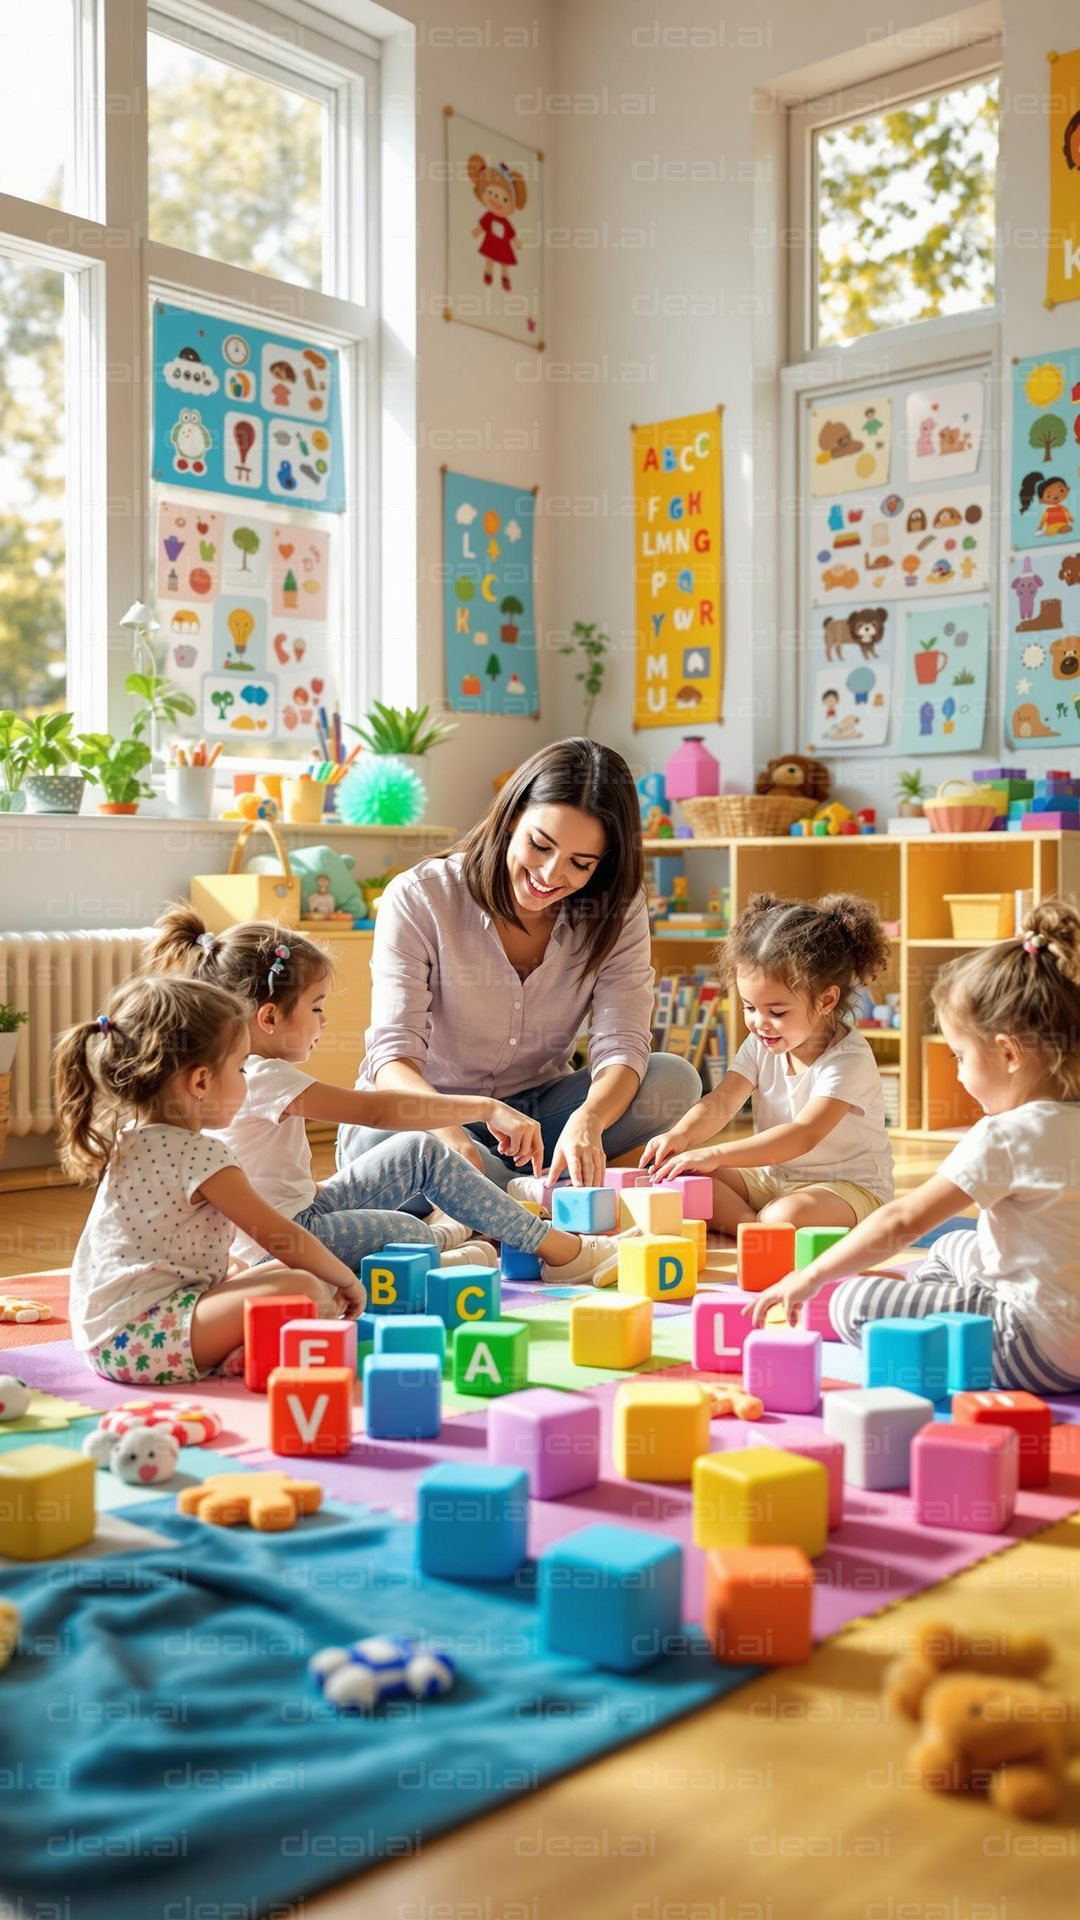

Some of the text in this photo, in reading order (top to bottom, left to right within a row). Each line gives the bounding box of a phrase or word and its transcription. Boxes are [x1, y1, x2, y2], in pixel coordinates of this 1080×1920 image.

[463, 532, 476, 559] L
[651, 571, 667, 598] P
[456, 607, 470, 634] K
[646, 654, 668, 681] M
[647, 687, 667, 713] U
[370, 1267, 397, 1306] B
[658, 1256, 684, 1291] D
[456, 1286, 486, 1321] C
[714, 1313, 741, 1356] L
[464, 1342, 502, 1384] A
[286, 1394, 330, 1444] V
